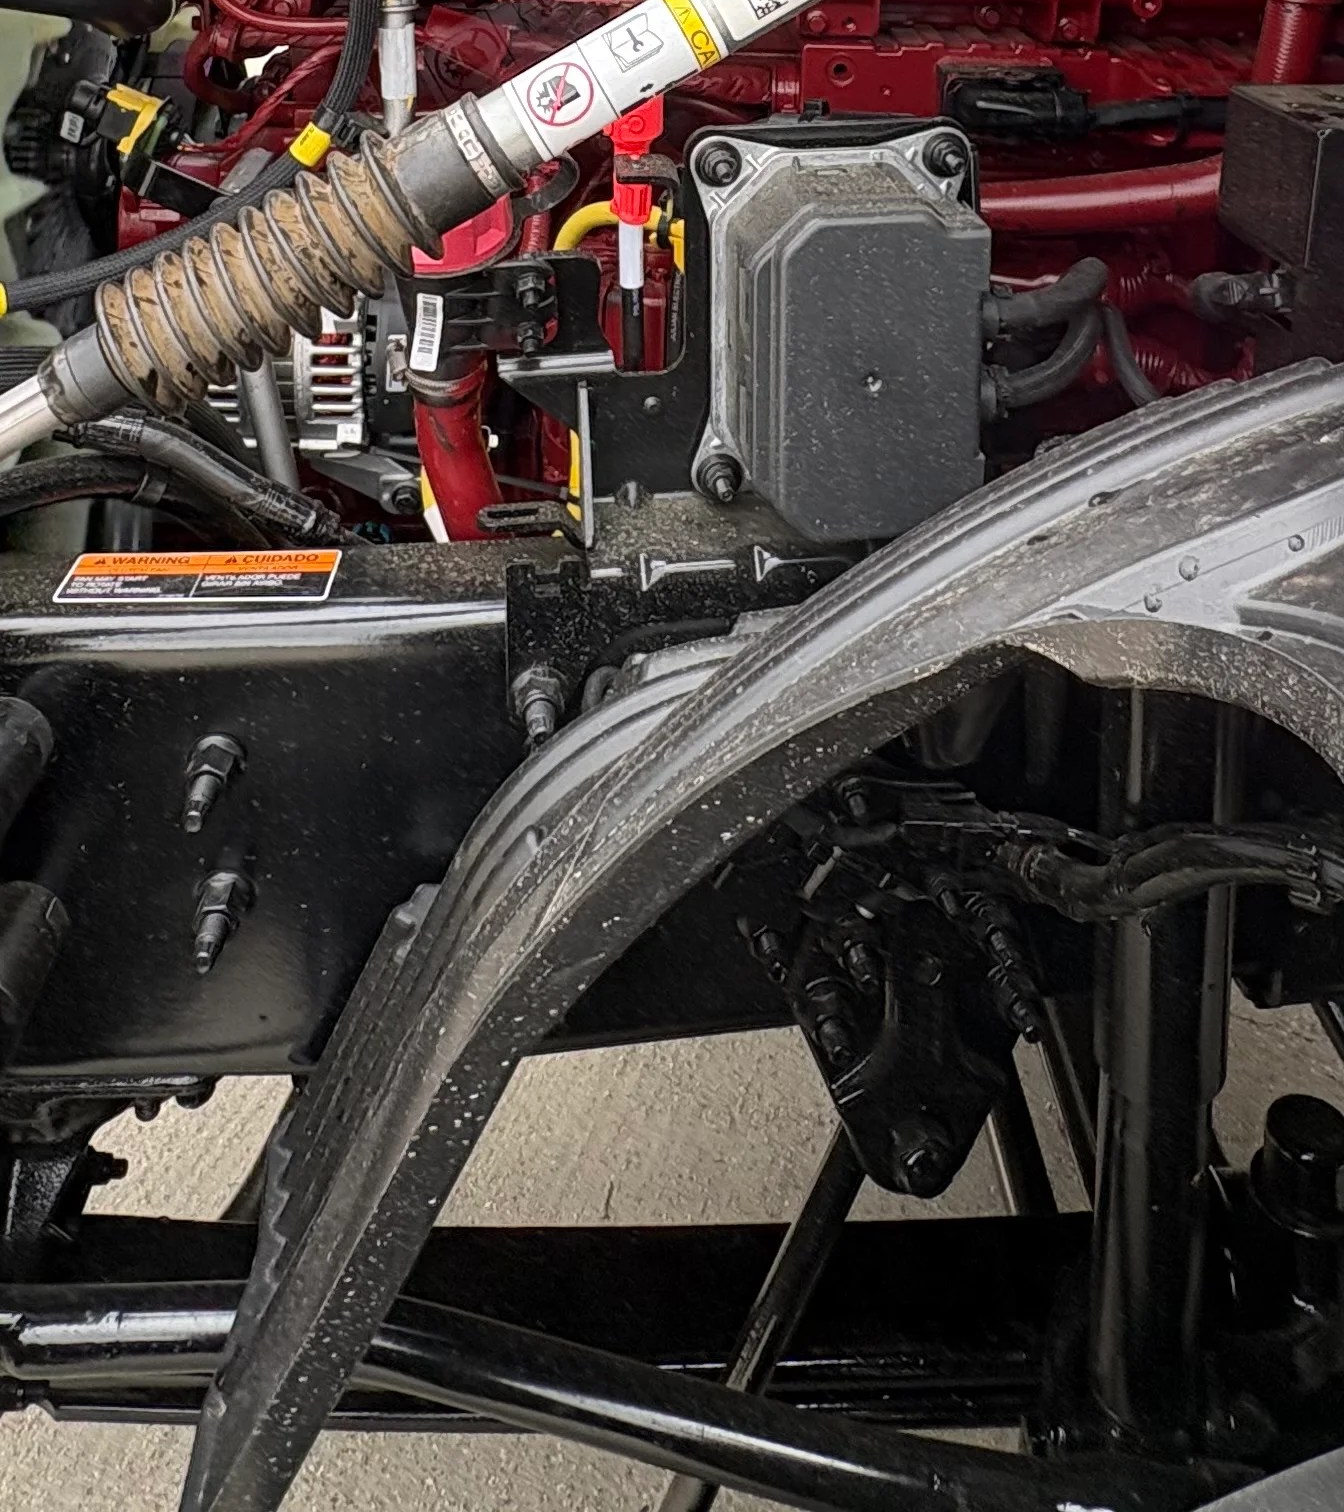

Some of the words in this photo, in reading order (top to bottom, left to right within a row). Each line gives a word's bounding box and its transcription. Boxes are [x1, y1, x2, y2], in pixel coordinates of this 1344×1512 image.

[690, 28, 722, 67] CA
[111, 556, 192, 565] WARNING
[242, 553, 319, 563] CUIDADO
